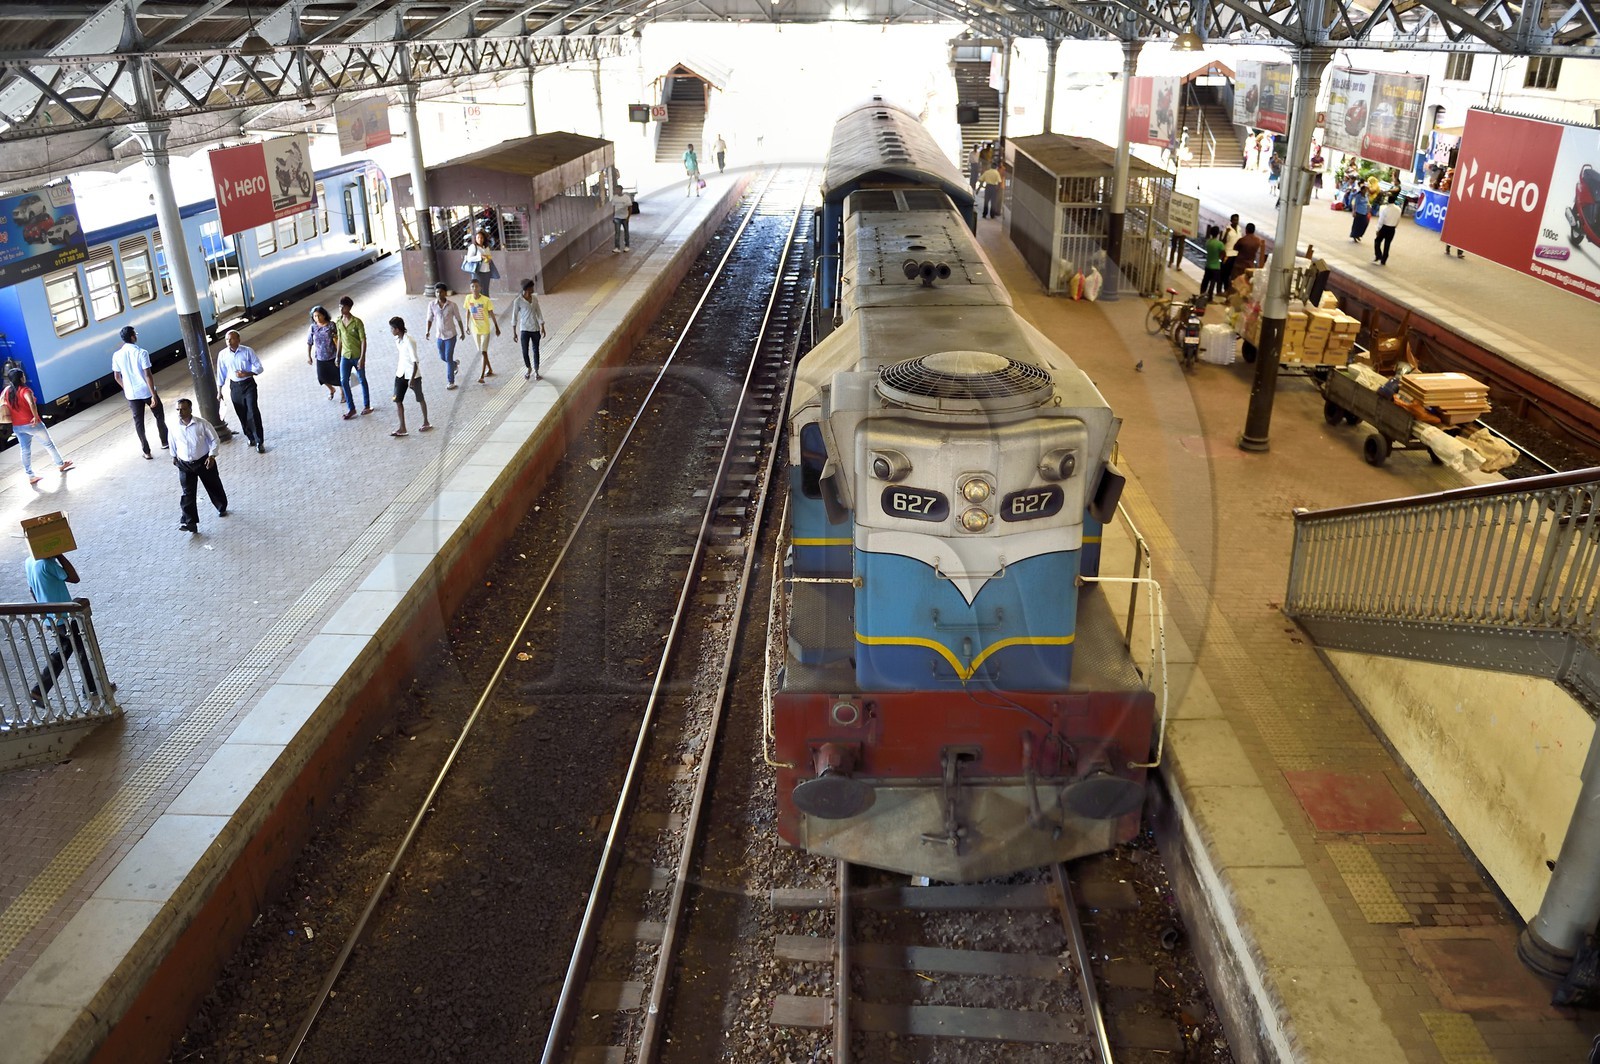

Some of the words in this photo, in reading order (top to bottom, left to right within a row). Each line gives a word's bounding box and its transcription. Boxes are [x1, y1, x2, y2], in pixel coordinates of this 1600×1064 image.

[467, 106, 481, 116] 06
[652, 107, 666, 116] 05
[51, 185, 68, 199] CDB
[234, 175, 266, 198] Hero
[1481, 171, 1539, 212] Hero
[1425, 202, 1447, 223] pep
[1543, 228, 1558, 241] 100cc
[893, 492, 937, 514] 627
[1011, 492, 1053, 515] 627
